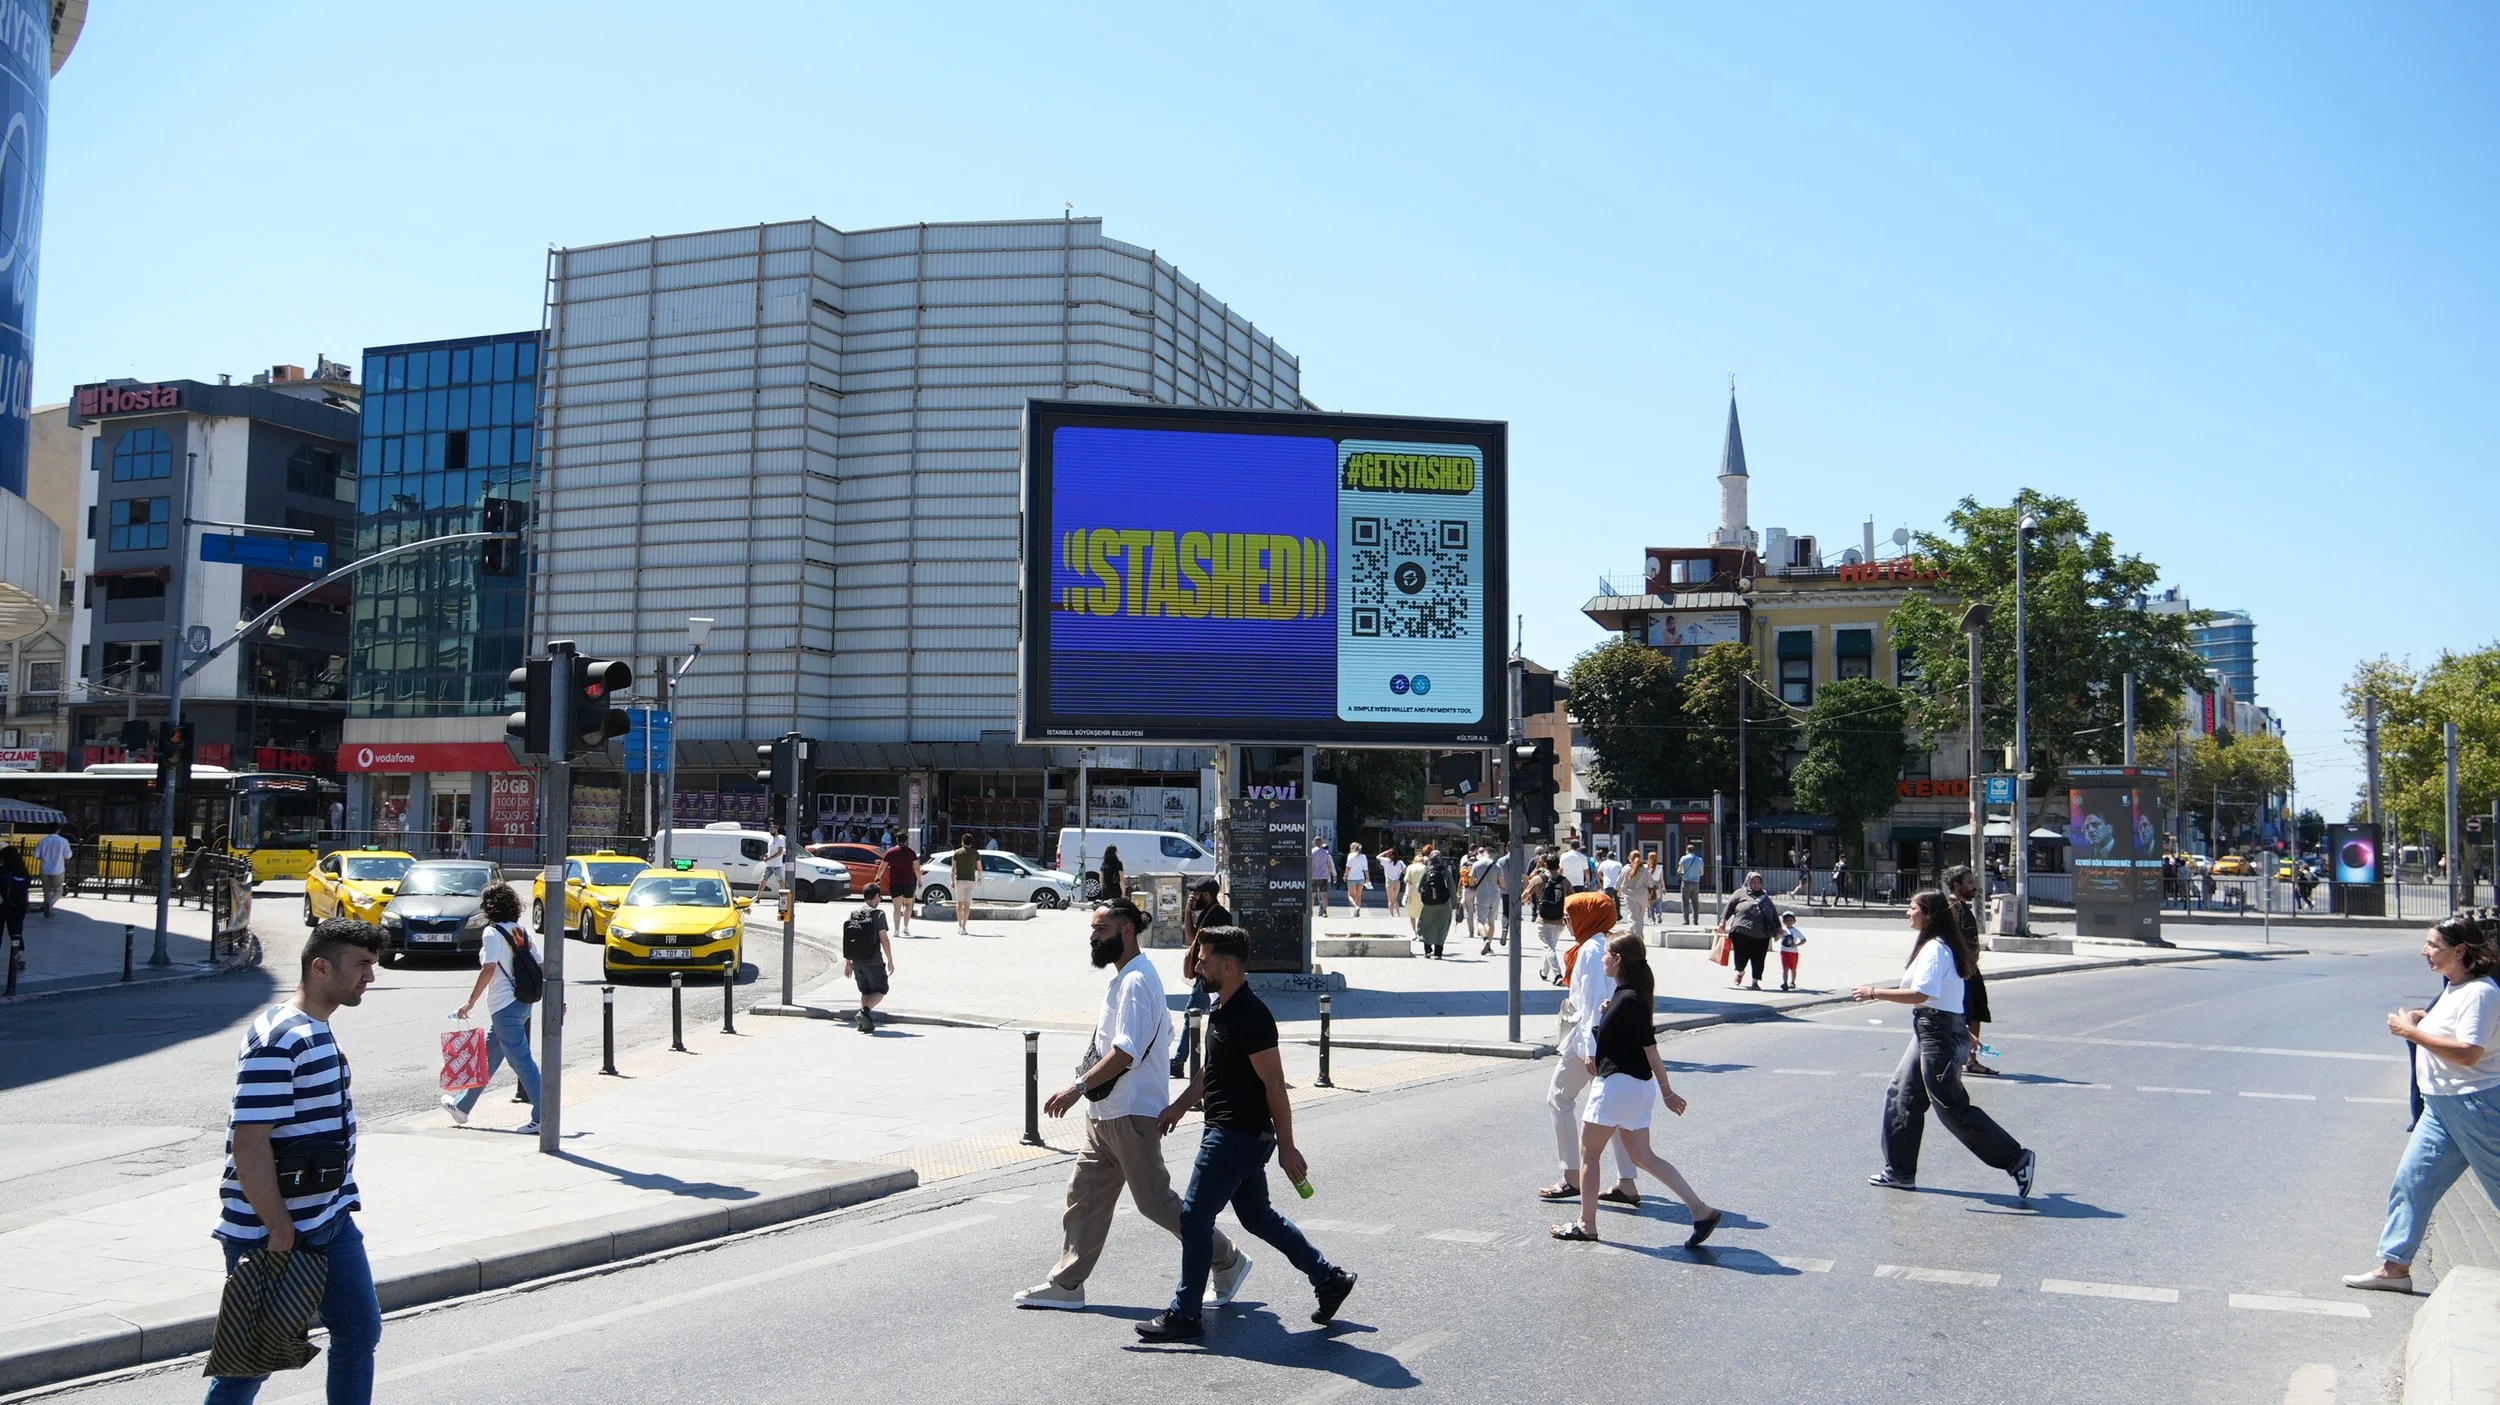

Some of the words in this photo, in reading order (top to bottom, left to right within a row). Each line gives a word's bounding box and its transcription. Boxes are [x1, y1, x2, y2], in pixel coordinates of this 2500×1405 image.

[101, 384, 179, 413] Hosta
[1347, 453, 1474, 491] #GETSTASHED
[375, 753, 415, 764] vodafone
[494, 780, 509, 793] 20
[510, 780, 529, 794] GB
[1269, 823, 1305, 832] DUMAN
[1269, 881, 1306, 890] DUMAN
[665, 935, 677, 944] FIAT
[451, 1048, 471, 1073] Bsk
